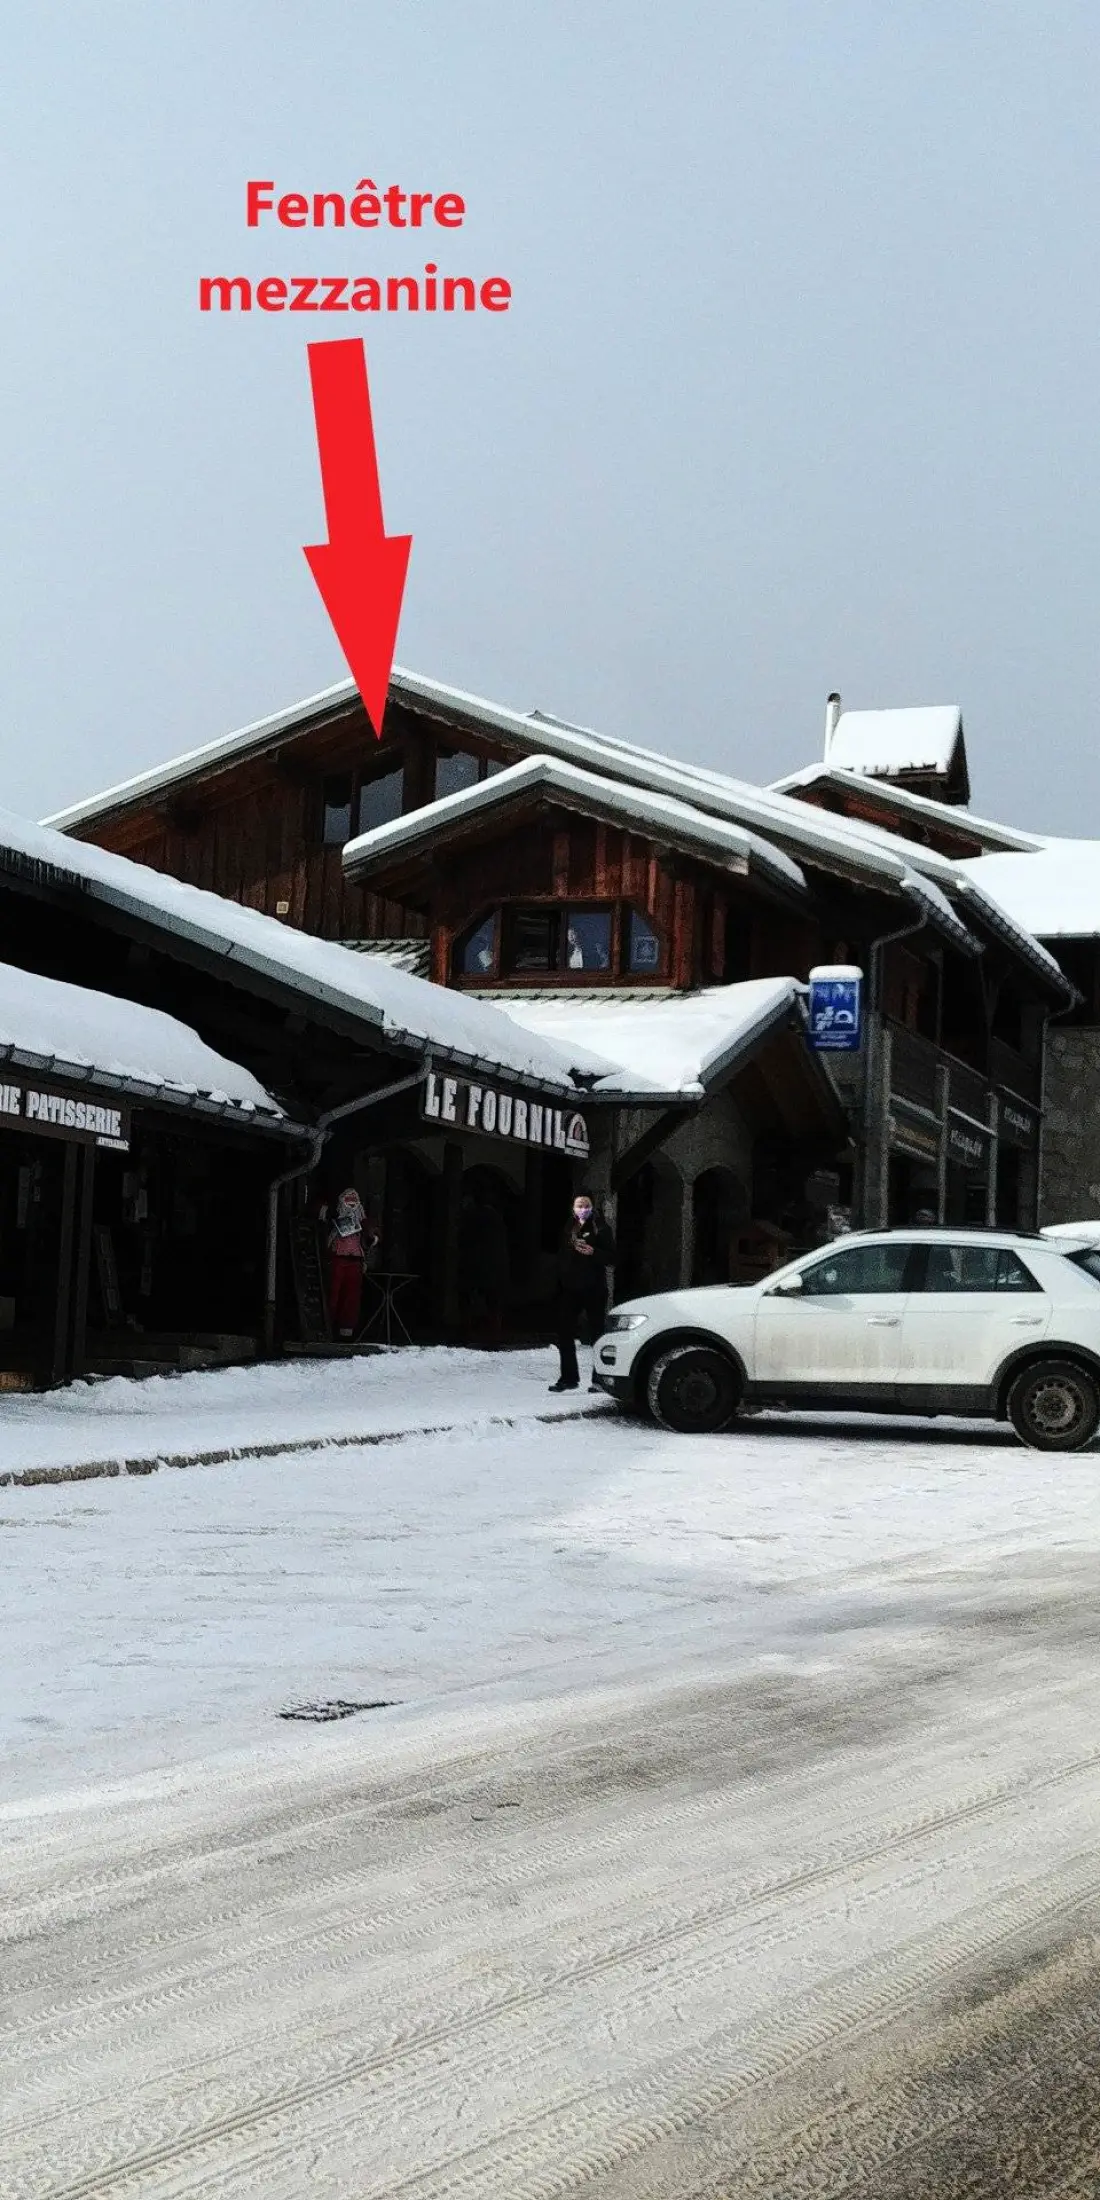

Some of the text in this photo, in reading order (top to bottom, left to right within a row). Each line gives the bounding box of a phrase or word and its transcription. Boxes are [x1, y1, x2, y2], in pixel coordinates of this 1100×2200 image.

[25, 1090, 122, 1137] PATISSERIE
[424, 1073, 566, 1149] LE FOURNIL
